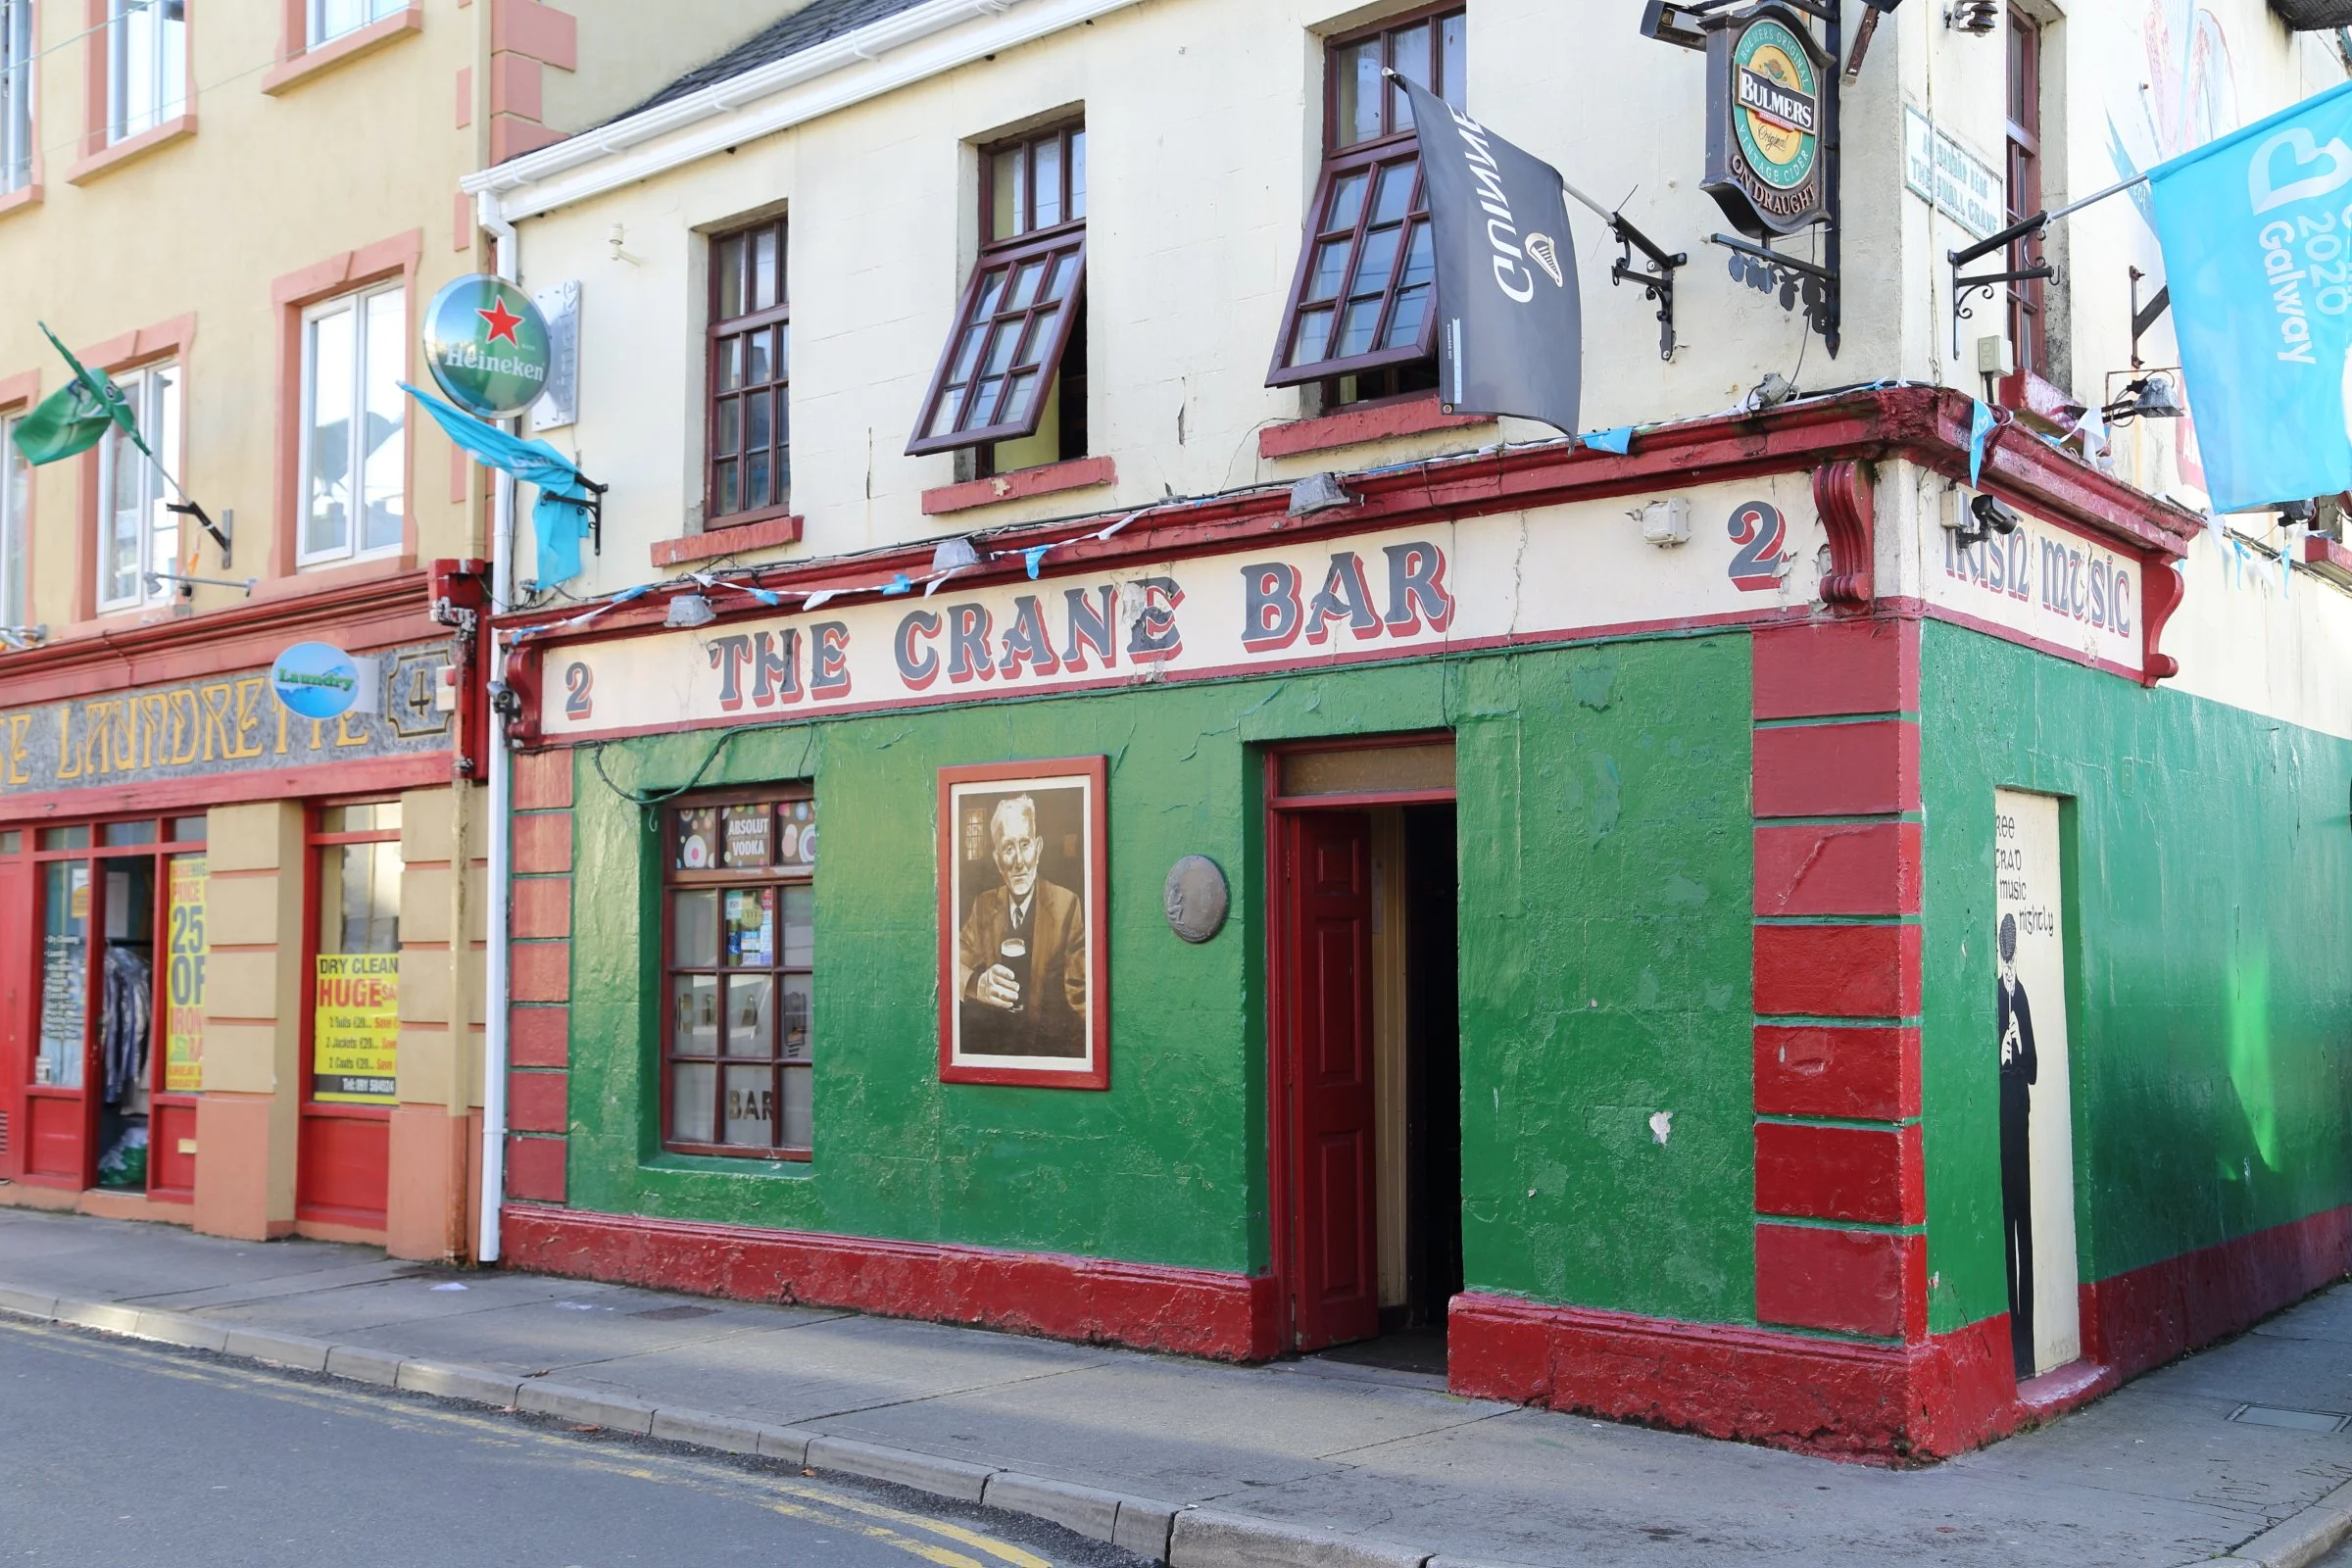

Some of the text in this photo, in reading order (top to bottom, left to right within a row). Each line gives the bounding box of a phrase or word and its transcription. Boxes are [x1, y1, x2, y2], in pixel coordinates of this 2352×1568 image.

[1740, 28, 1809, 86] BULMERS ORIGINAL
[1741, 74, 1811, 127] BULMERS
[1740, 123, 1809, 182] VINTAGE CIDER
[1758, 122, 1788, 151] Original
[1733, 155, 1816, 215] ON DRAUGHT
[1911, 156, 1932, 190] THE
[1968, 198, 1997, 234] CRANE
[2297, 211, 2350, 316] 2020
[2258, 220, 2317, 365] Galway
[445, 347, 544, 381] Heineken
[564, 500, 1788, 720] 2 THE CRANE BAR 2
[278, 667, 354, 692] Laundry
[409, 668, 430, 719] 4
[728, 818, 769, 836] ABSOLUT
[732, 840, 764, 857] VODKA
[1999, 876, 2027, 901] music
[172, 906, 204, 954] 25
[2019, 904, 2054, 937] nightly
[172, 955, 205, 1004] OF
[319, 957, 398, 974] DRY CLEAN
[319, 978, 383, 1007] HUGE
[728, 1090, 772, 1120] BAR
